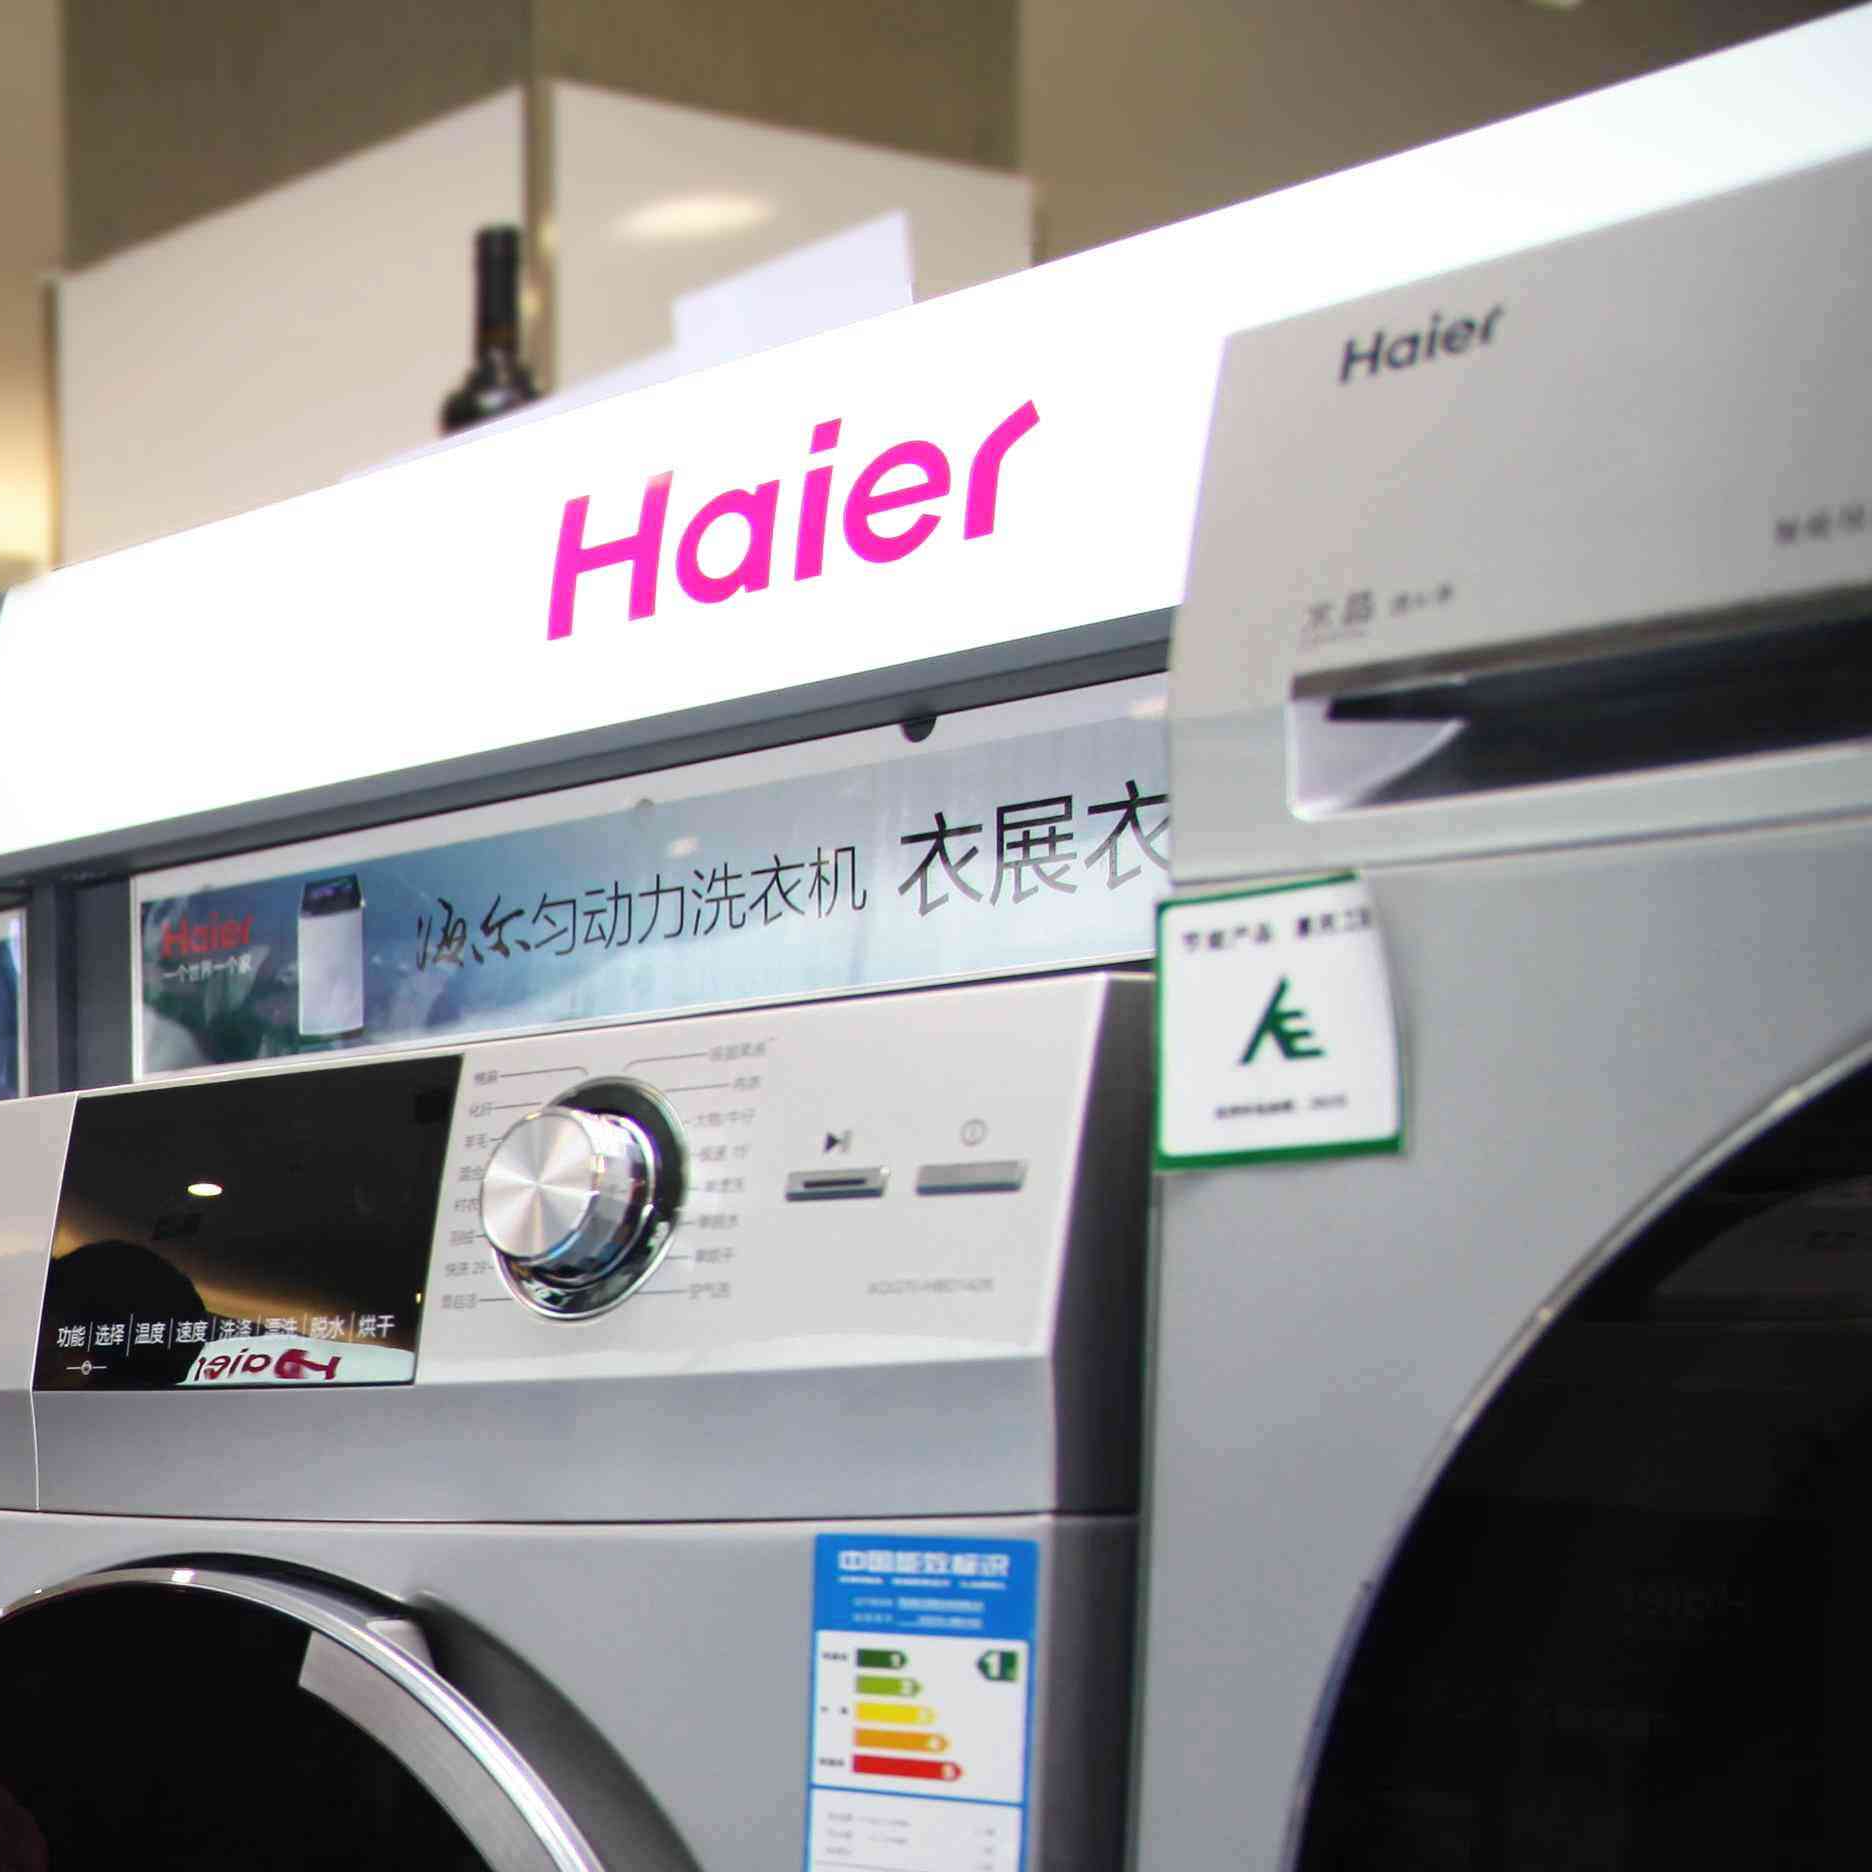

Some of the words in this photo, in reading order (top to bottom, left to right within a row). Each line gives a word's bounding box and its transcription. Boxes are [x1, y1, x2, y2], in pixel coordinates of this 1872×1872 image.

[1338, 303, 1506, 385] Haier
[547, 400, 1040, 641] Haier
[160, 911, 256, 958] Haier
[57, 1326, 85, 1348] 功能
[94, 1323, 124, 1346] 选择
[135, 1322, 165, 1344] 温度
[176, 1321, 208, 1344] 速度
[309, 1317, 345, 1339] 脱水
[359, 1314, 395, 1338] 烘干
